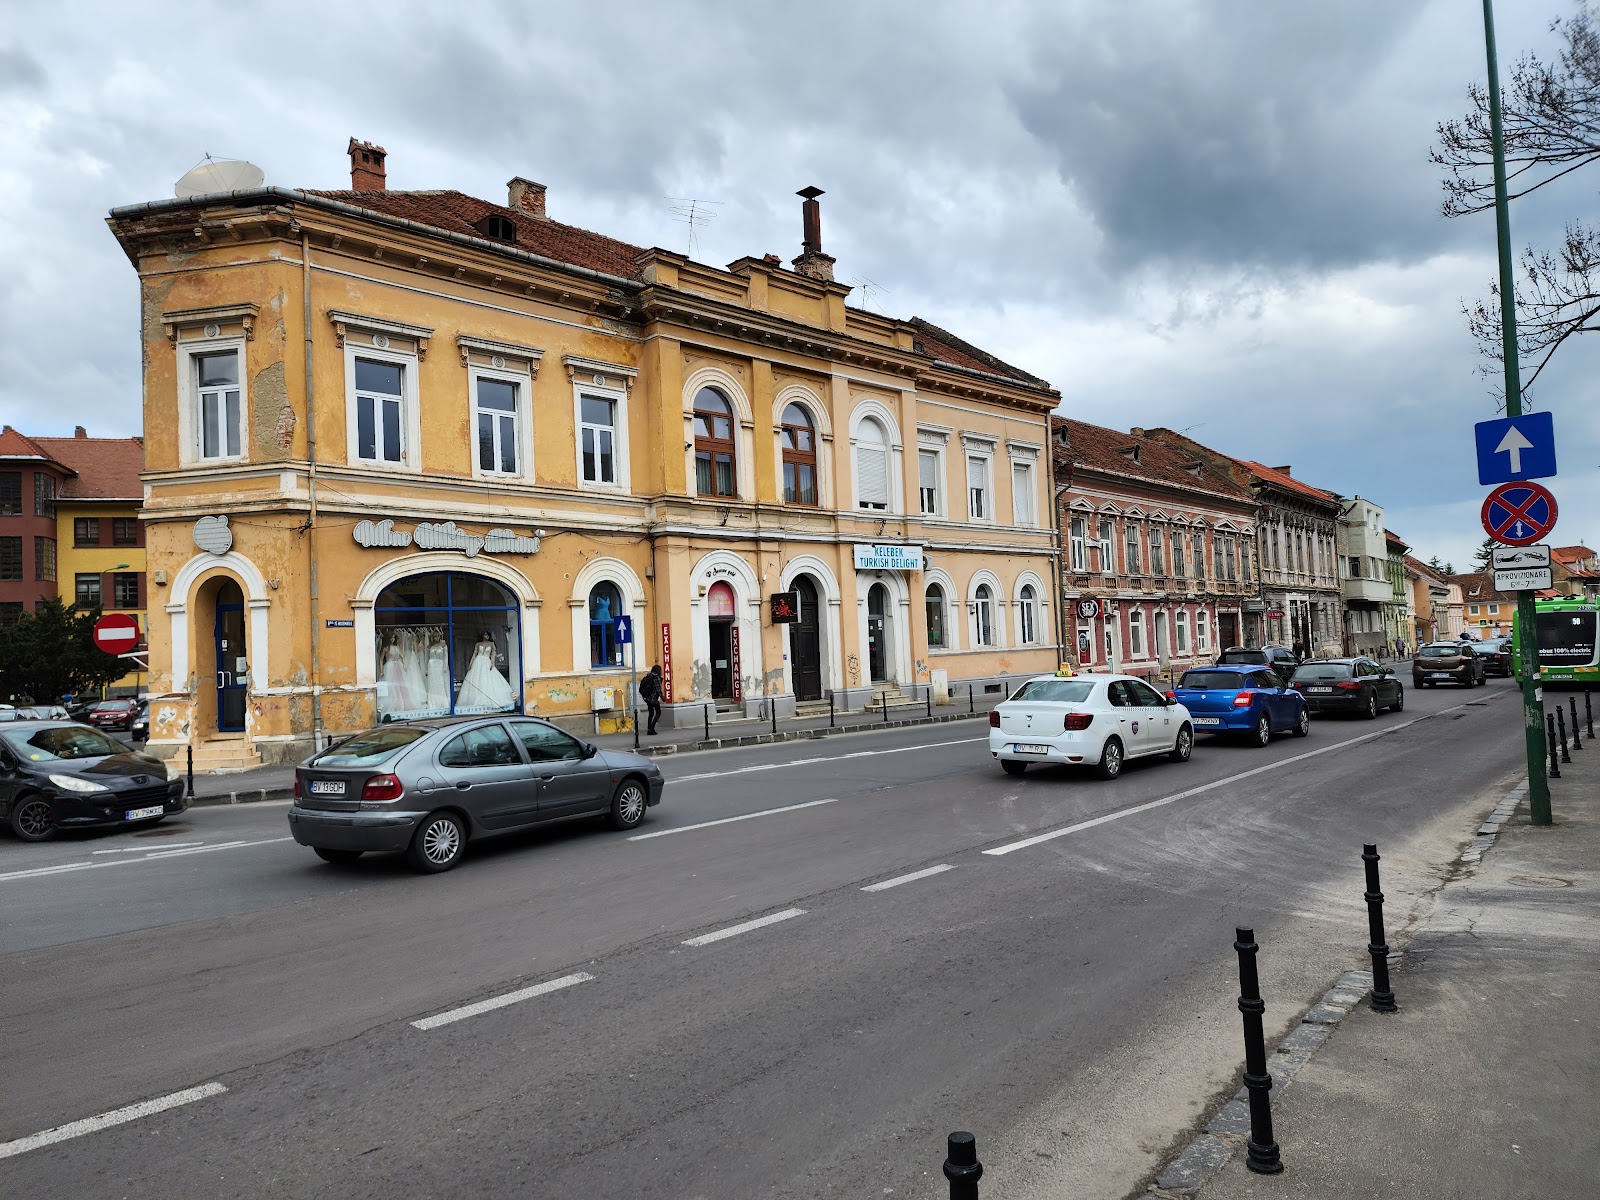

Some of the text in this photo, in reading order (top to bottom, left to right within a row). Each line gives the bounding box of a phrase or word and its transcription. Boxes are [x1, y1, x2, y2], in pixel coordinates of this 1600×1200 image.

[874, 547, 904, 557] KELEBEK
[860, 557, 918, 569] TURKISH DELIGHT
[1496, 570, 1549, 581] APROVIZIONARE
[1081, 602, 1095, 611] SEX
[663, 626, 672, 700] EXCHANGE
[732, 629, 740, 698] EXCHANGE
